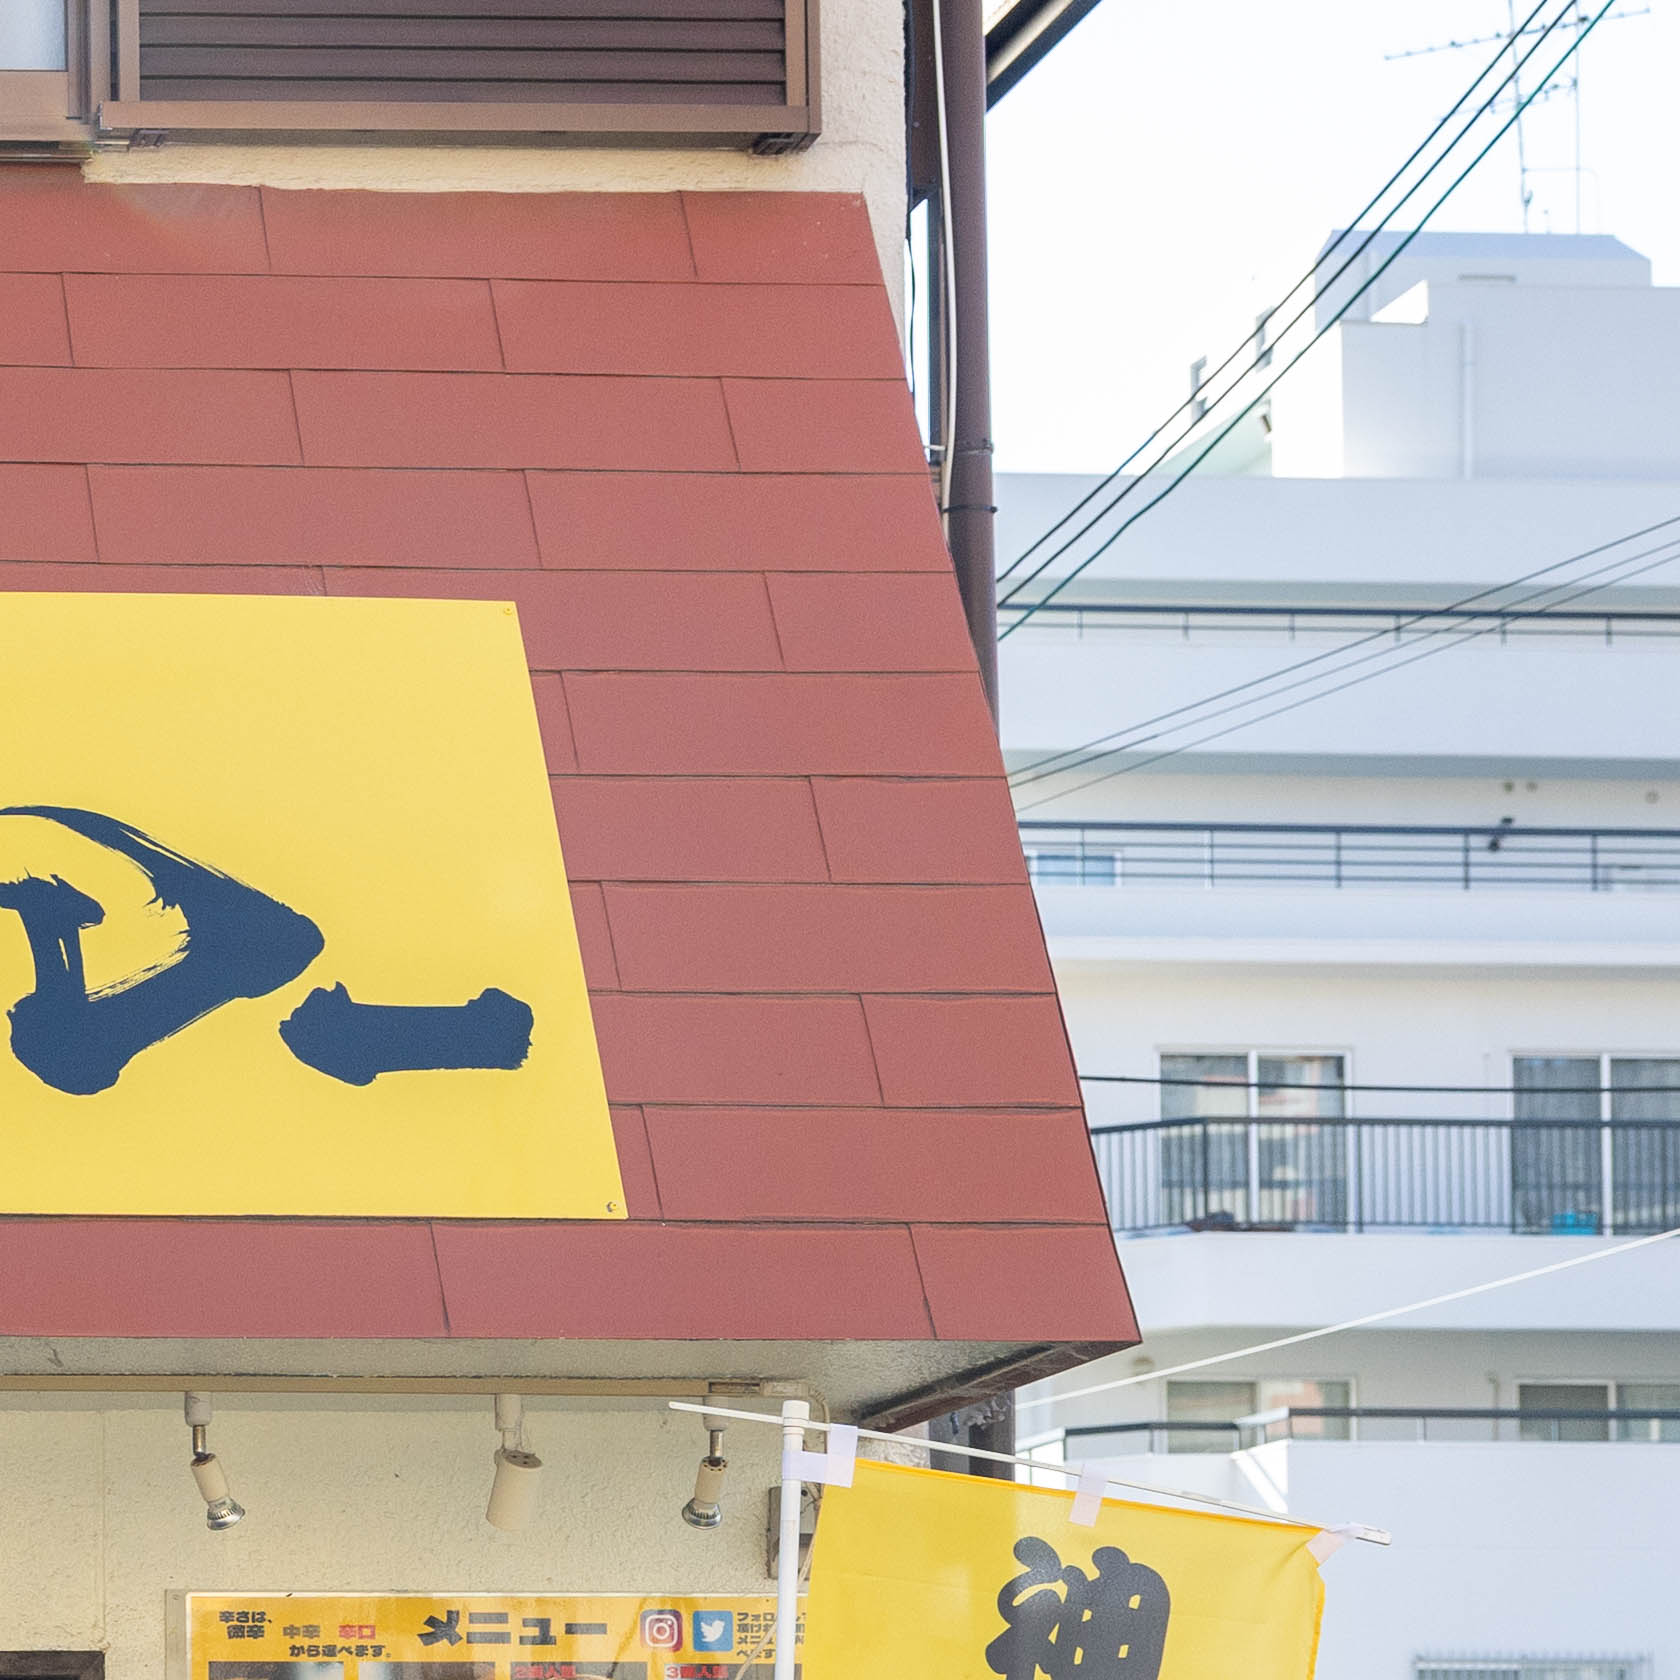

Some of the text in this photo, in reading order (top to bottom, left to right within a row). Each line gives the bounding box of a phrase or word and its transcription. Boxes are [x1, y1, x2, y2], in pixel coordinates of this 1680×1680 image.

[283, 1624, 376, 1640] 中辛 辛口
[417, 1610, 607, 1646] メニュー
